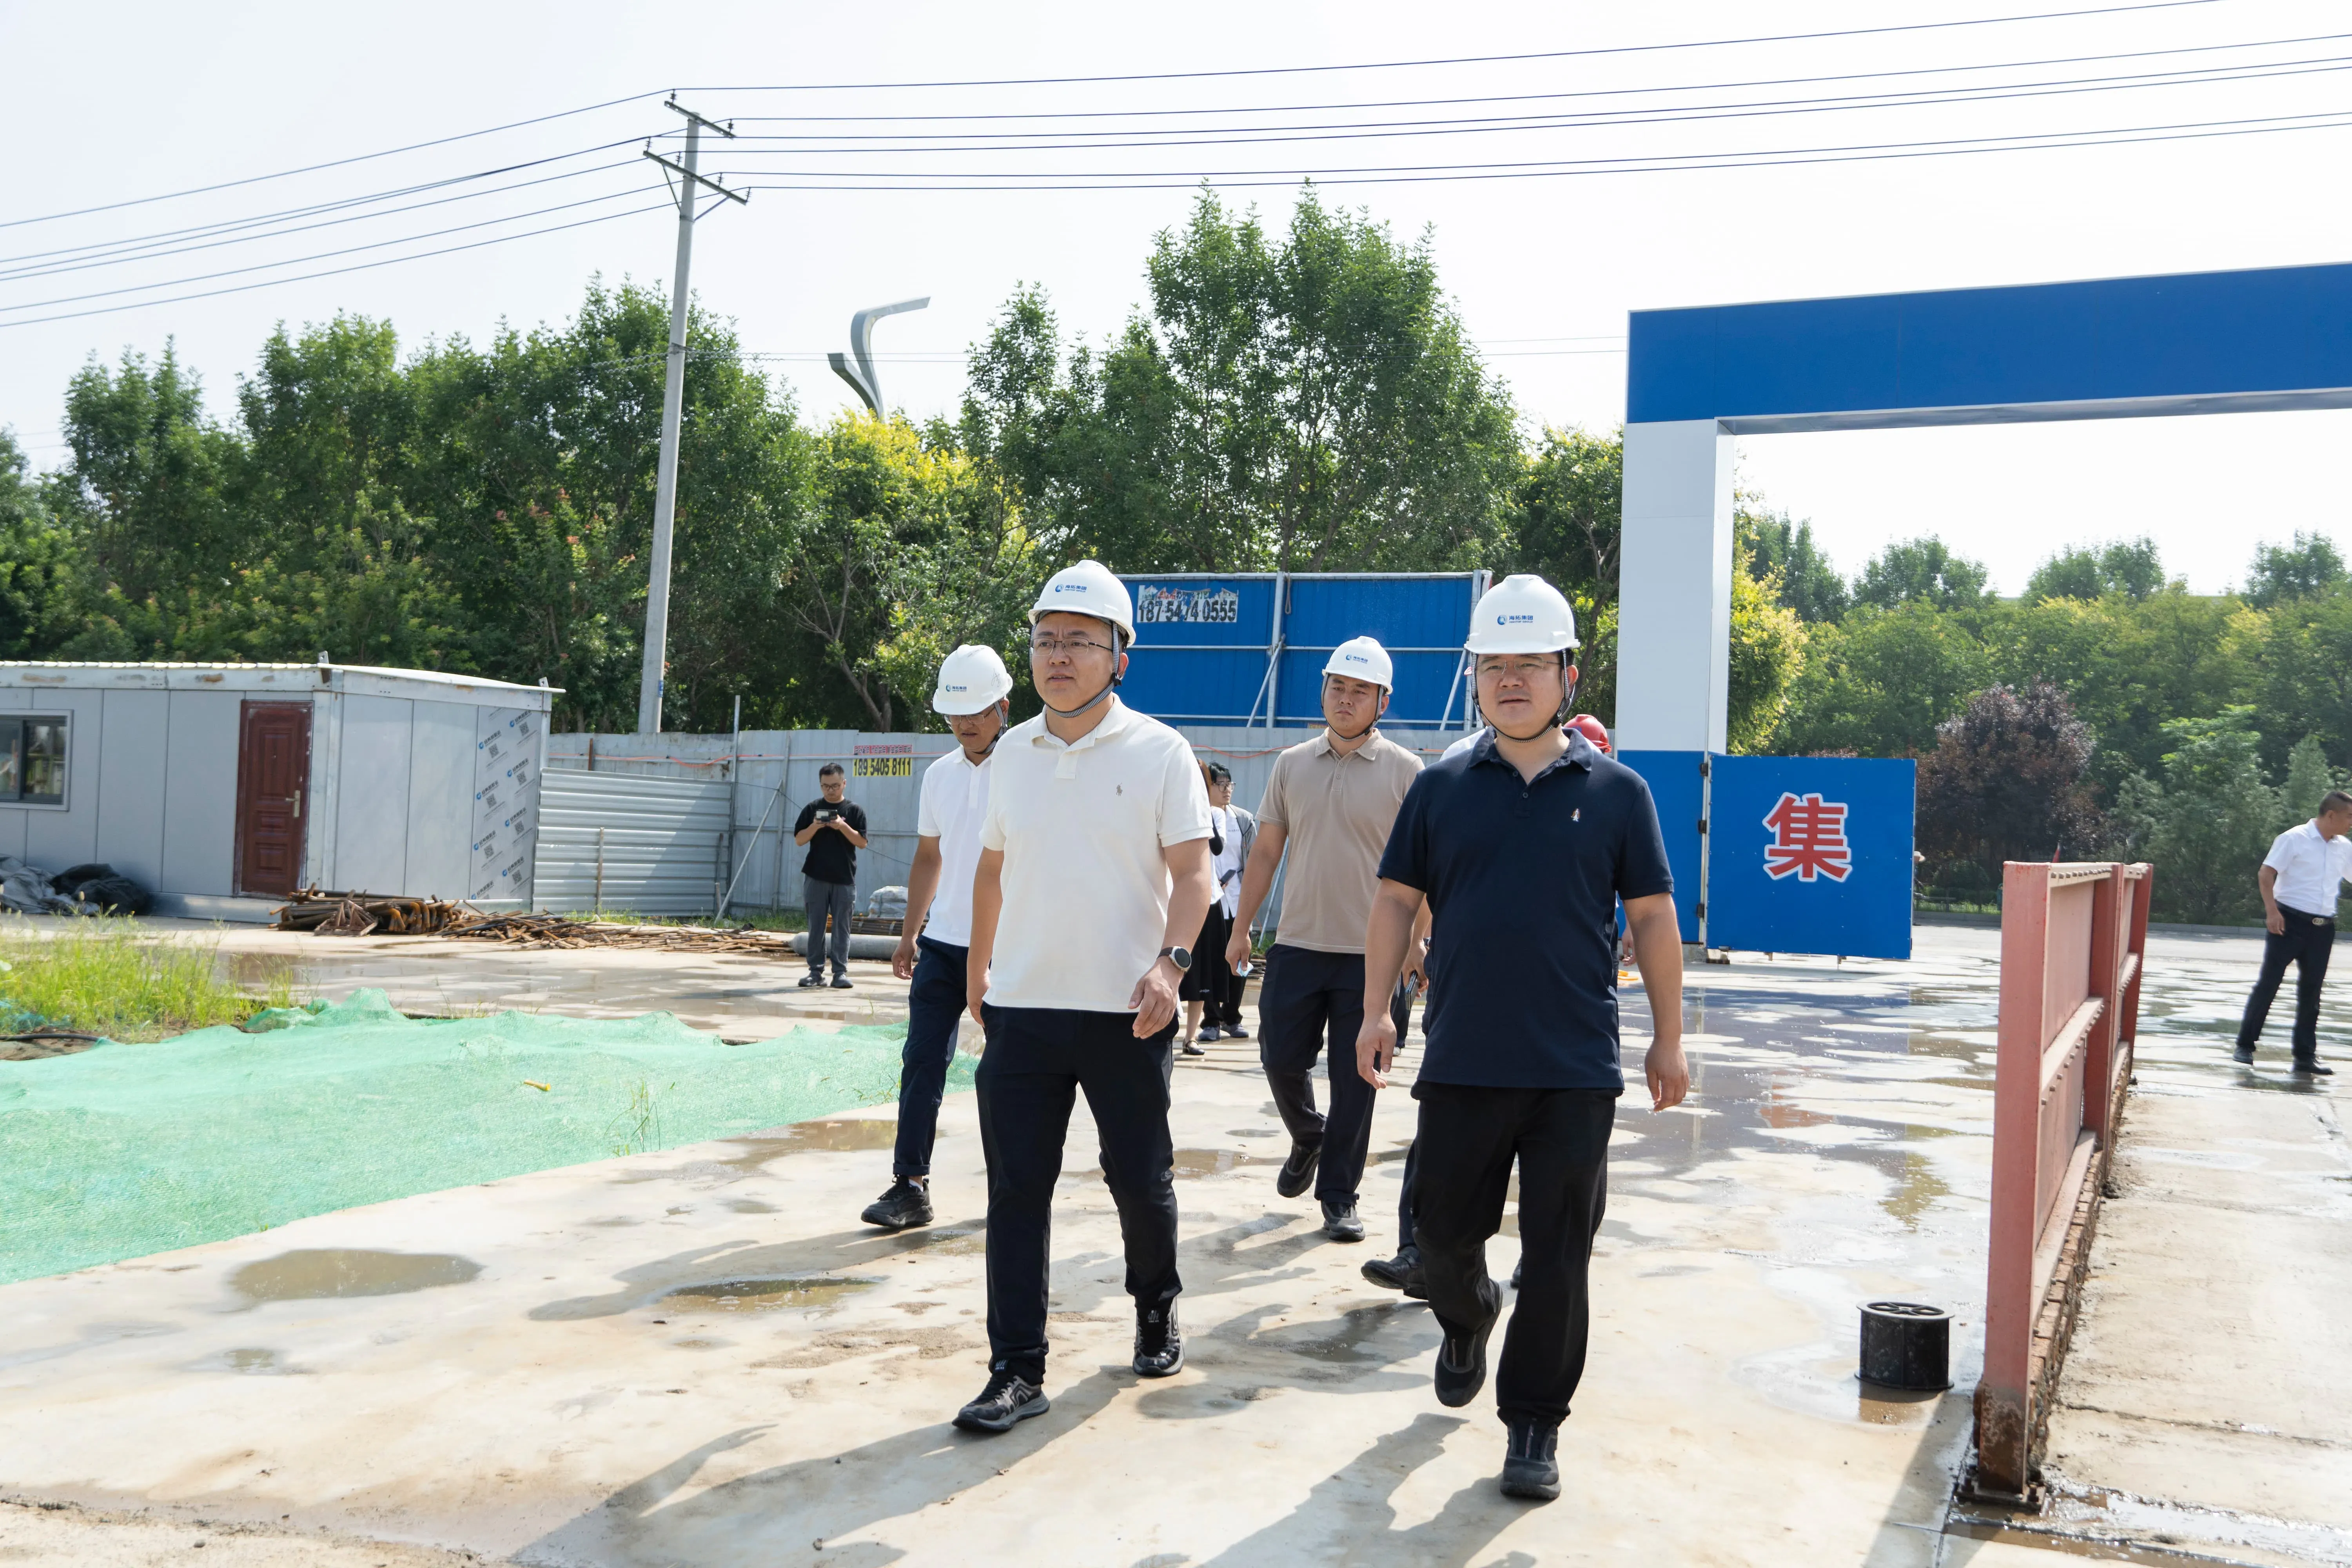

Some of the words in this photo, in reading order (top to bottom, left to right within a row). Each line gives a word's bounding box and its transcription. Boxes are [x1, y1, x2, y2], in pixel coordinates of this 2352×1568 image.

[854, 758, 867, 776] 189
[870, 758, 889, 776] 5405
[892, 757, 911, 775] 8111
[1762, 792, 1852, 882] 集
